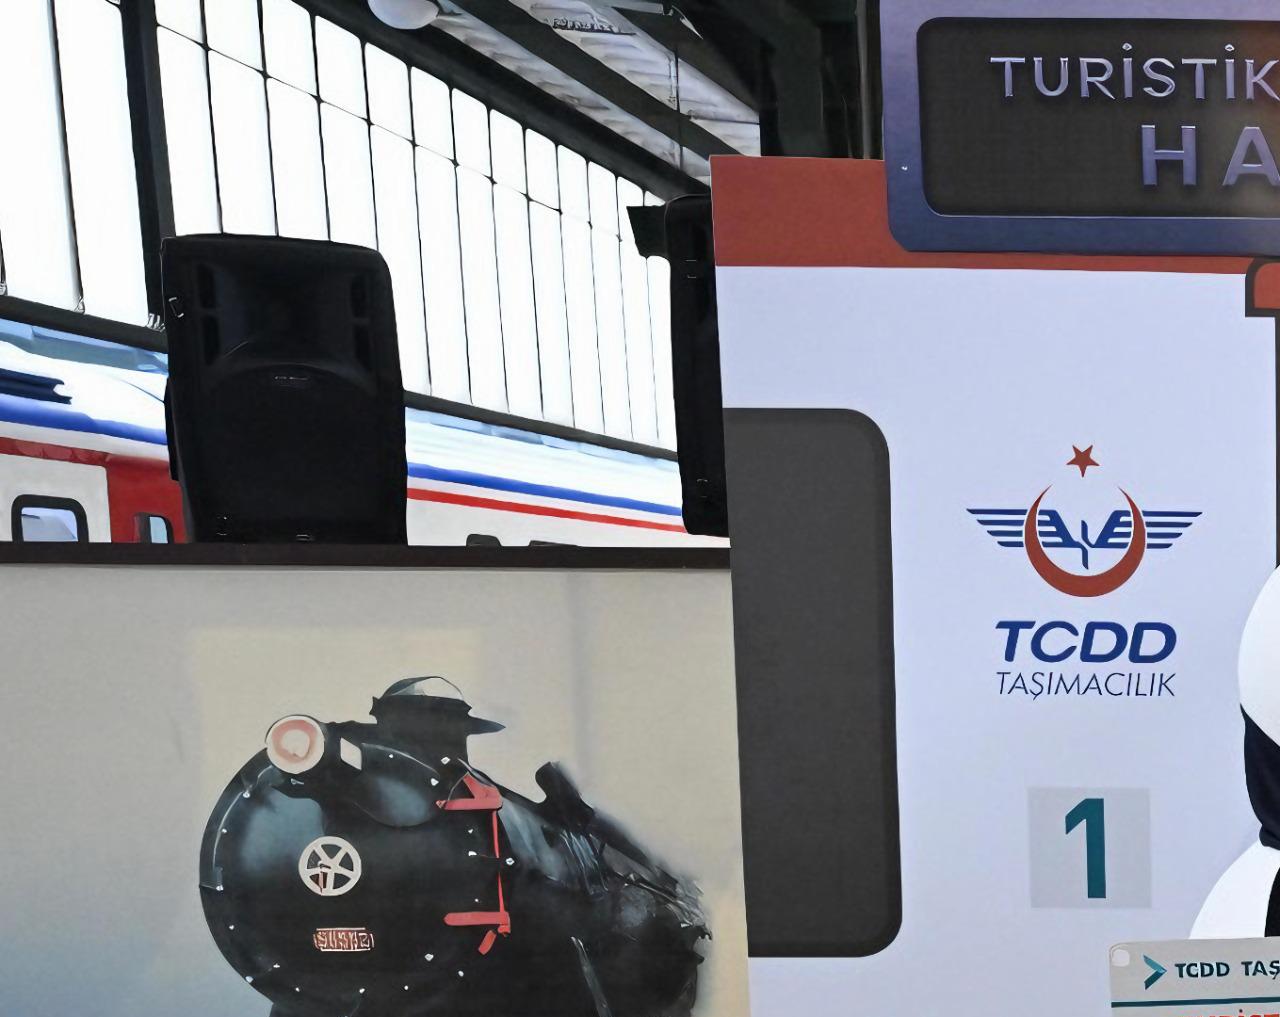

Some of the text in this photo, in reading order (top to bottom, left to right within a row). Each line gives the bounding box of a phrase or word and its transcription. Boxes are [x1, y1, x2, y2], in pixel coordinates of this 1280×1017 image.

[990, 43, 1280, 101] TURİSTİK
[995, 620, 1177, 663] TCDD
[996, 672, 1176, 700] TAŞIMACILIK
[1064, 797, 1107, 899] 1
[1174, 961, 1230, 979] TCDD
